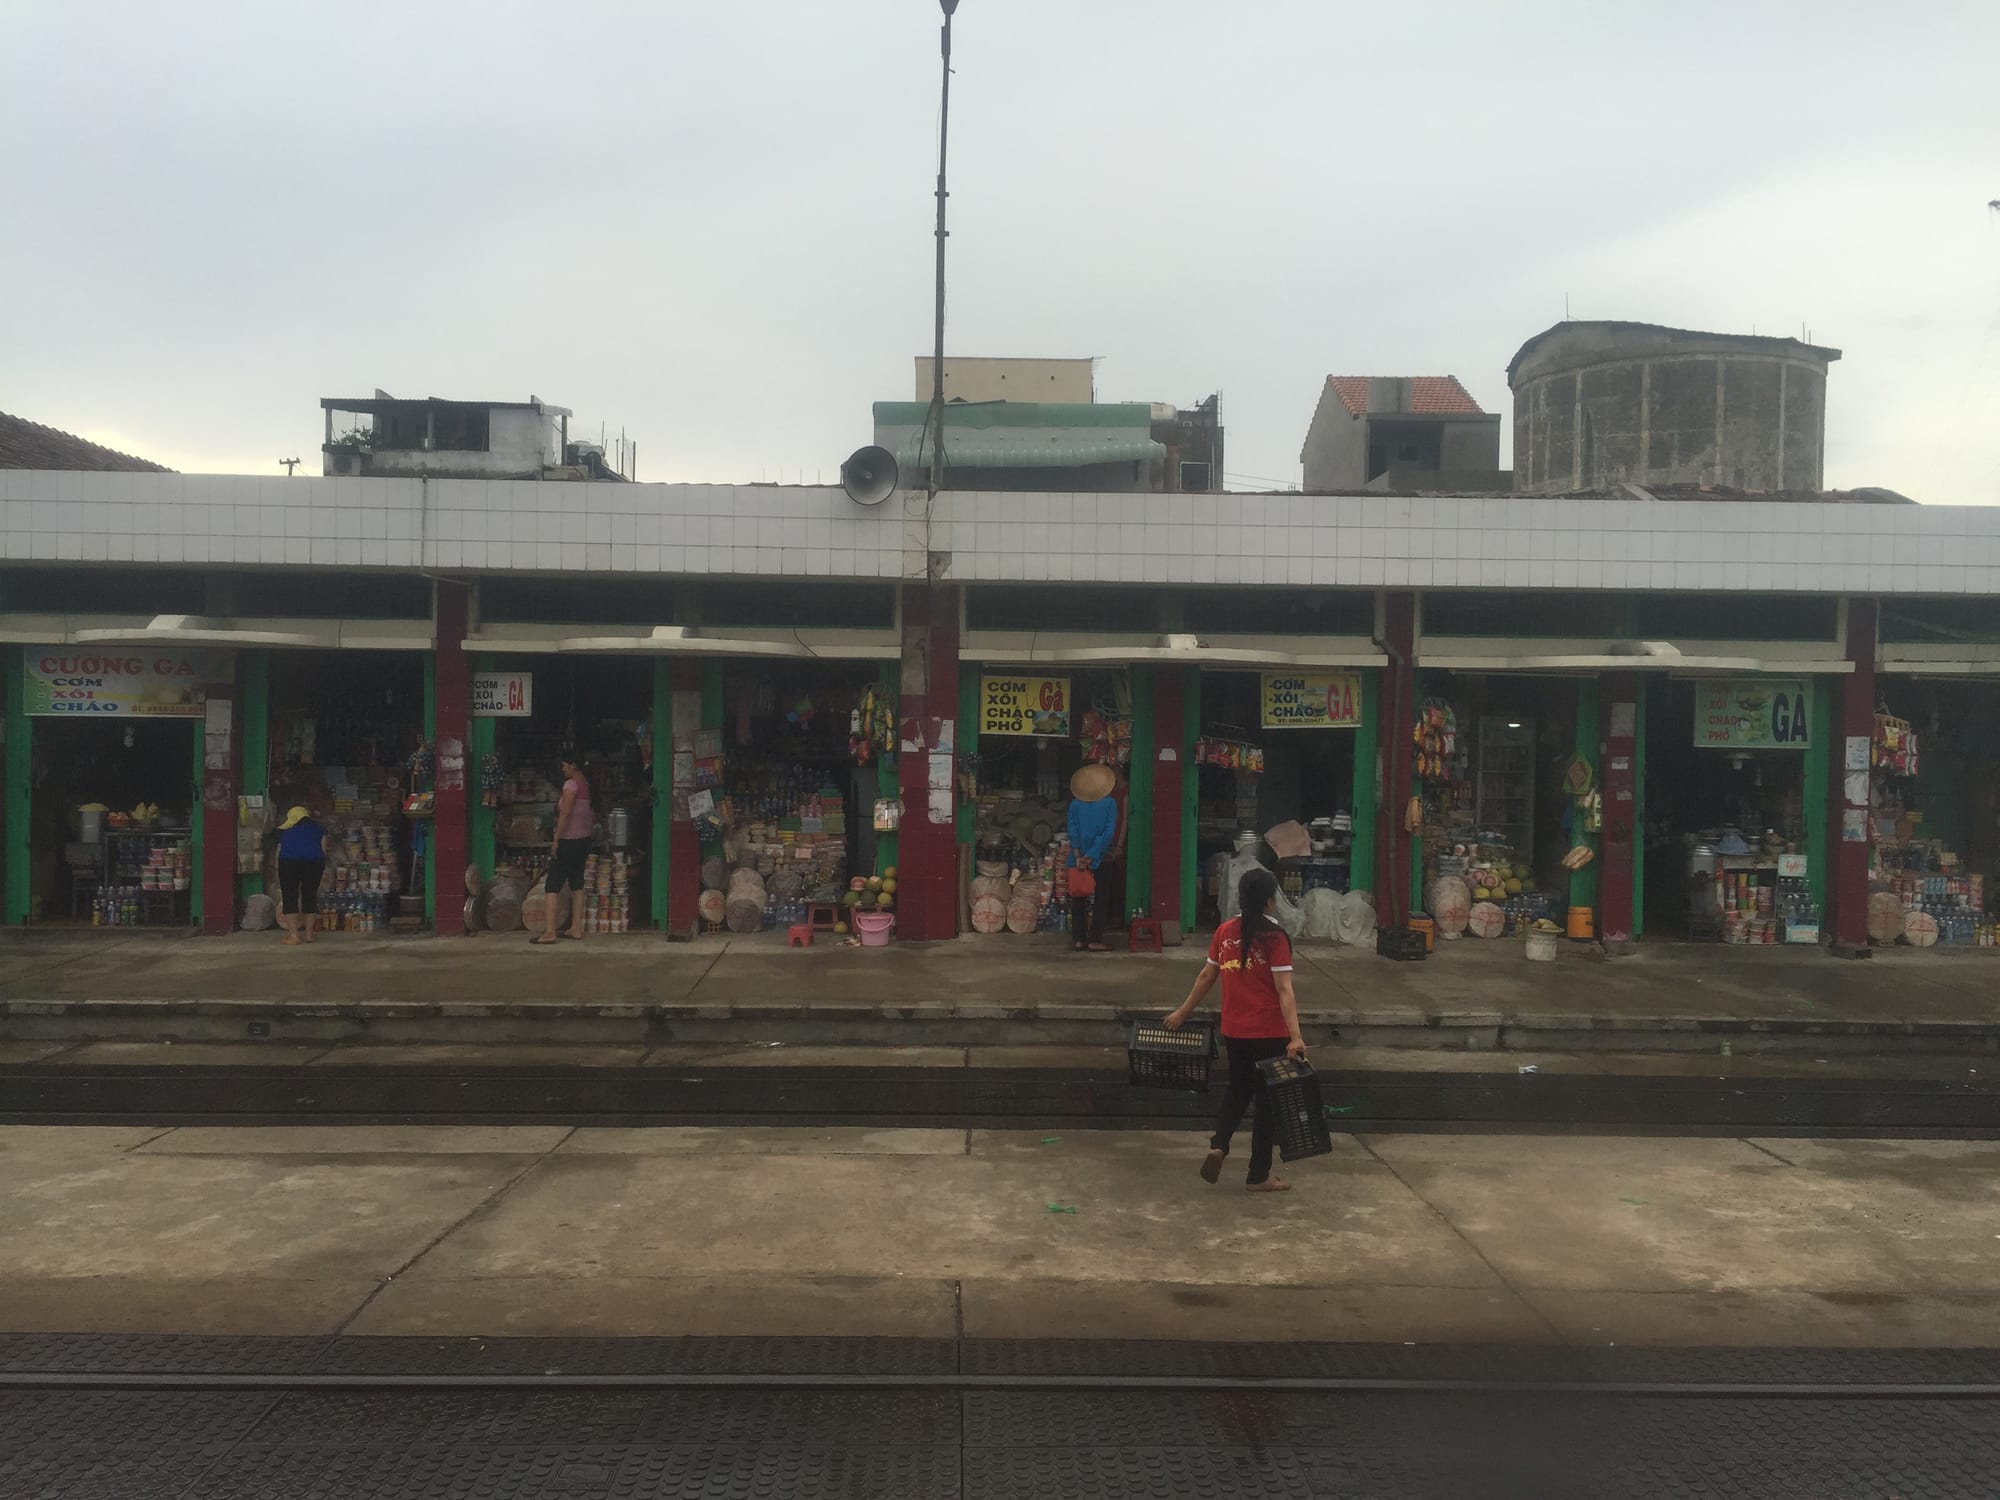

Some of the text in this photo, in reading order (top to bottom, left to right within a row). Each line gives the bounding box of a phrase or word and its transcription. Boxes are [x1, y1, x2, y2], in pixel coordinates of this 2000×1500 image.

[52, 676, 103, 687] CƠM
[987, 681, 1026, 693] CƠM
[52, 688, 95, 699] XÔI
[987, 693, 1017, 706] XÔI
[1039, 680, 1065, 712] Gà
[51, 701, 119, 712] CHÁO
[986, 706, 1035, 719] CHÁO
[1771, 682, 1808, 743] GÀ
